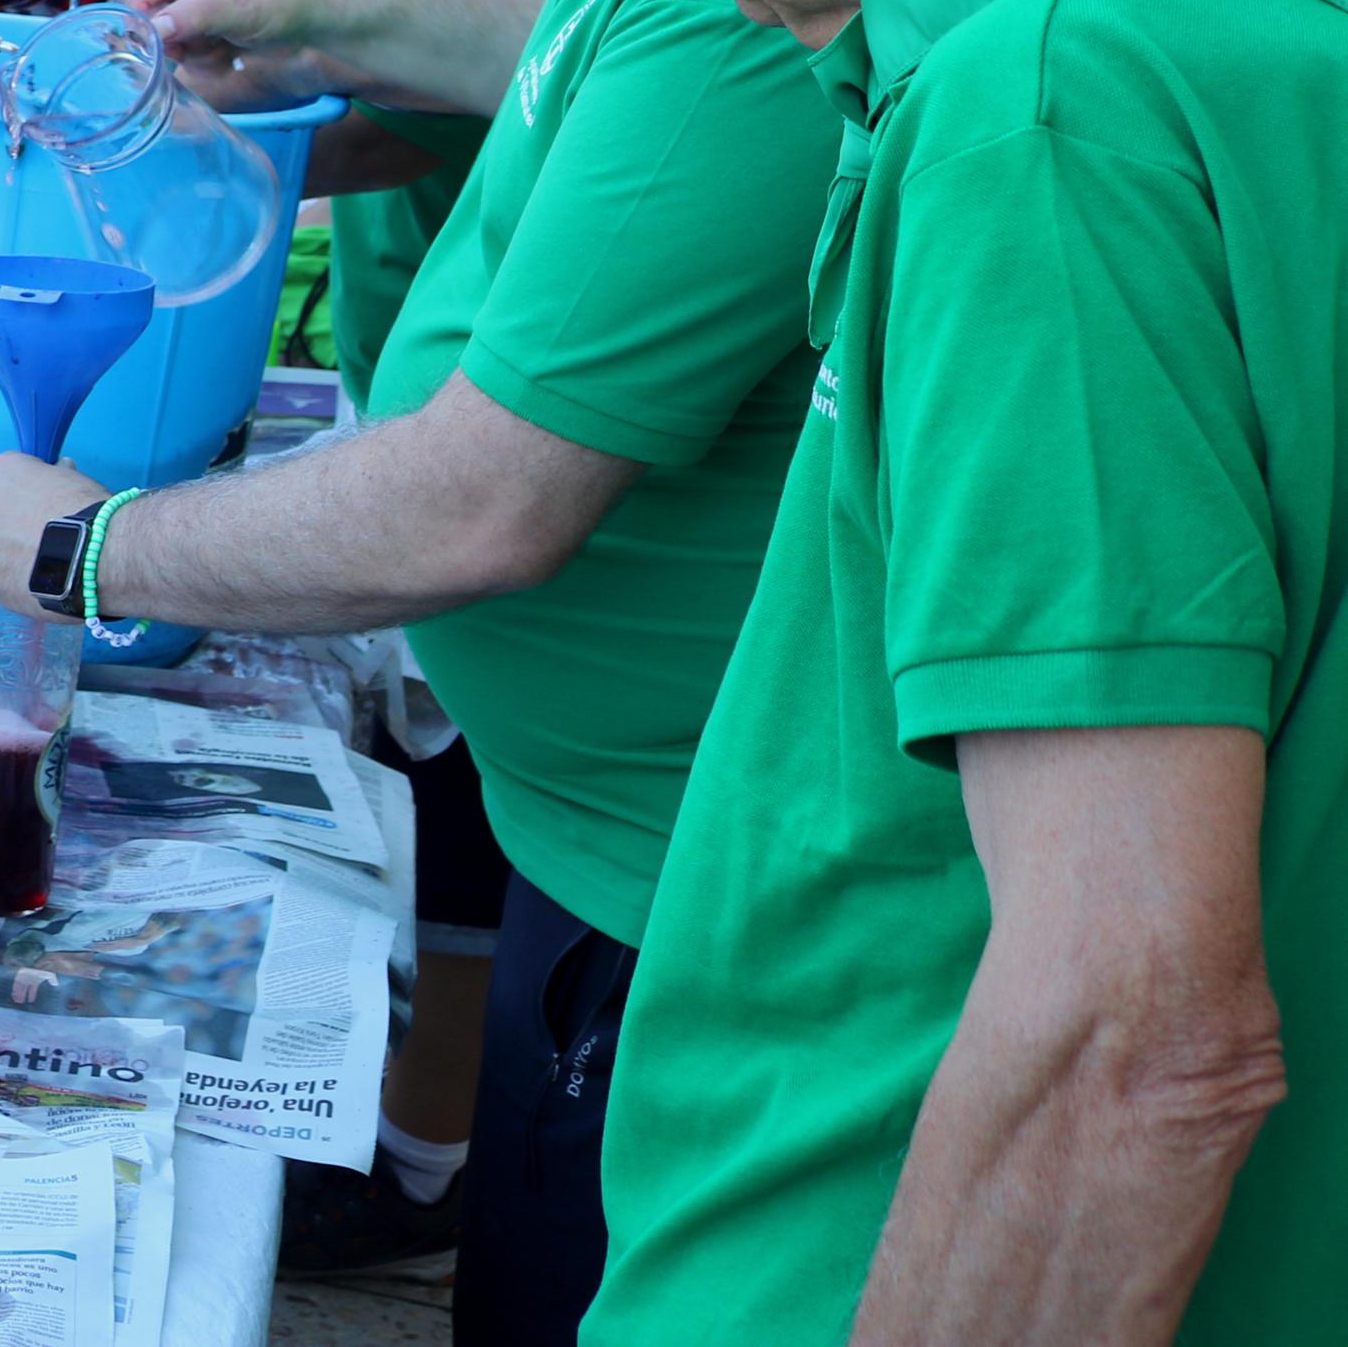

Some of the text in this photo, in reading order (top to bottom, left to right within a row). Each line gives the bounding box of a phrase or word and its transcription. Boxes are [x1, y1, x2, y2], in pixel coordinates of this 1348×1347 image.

[185, 1071, 338, 1095] a la leyenda
[283, 1098, 333, 1118] Una
[196, 1115, 312, 1140] DEPORTES
[47, 1279, 65, 1293] hay
